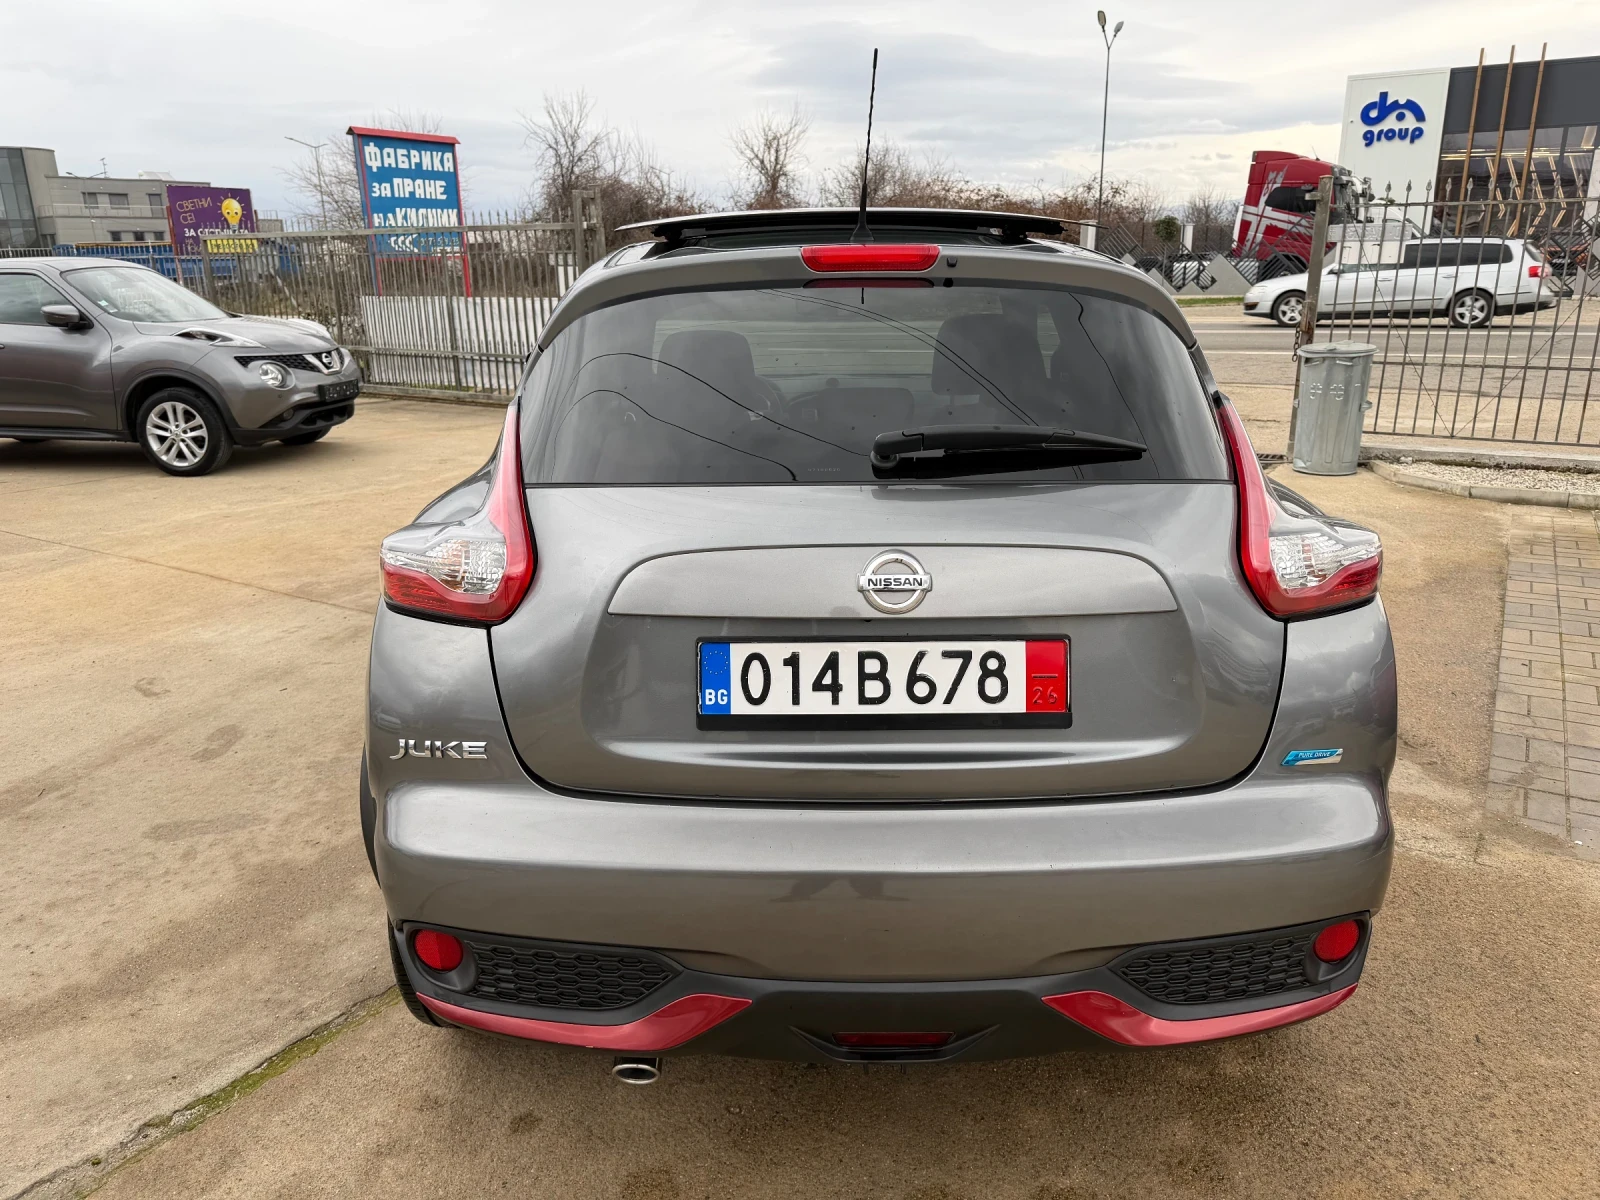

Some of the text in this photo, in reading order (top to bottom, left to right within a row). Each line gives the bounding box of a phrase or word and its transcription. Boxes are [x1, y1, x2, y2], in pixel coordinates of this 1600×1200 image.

[1362, 126, 1424, 147] group
[364, 142, 454, 172] ФАБРИКА
[393, 177, 447, 199] ПРАНЕ
[176, 197, 212, 212] СВЕТНИ
[184, 228, 196, 237] ЗА
[867, 577, 923, 587] NISSAN
[705, 688, 728, 705] BG
[1033, 686, 1058, 704] 26
[389, 739, 488, 760] JUKE
